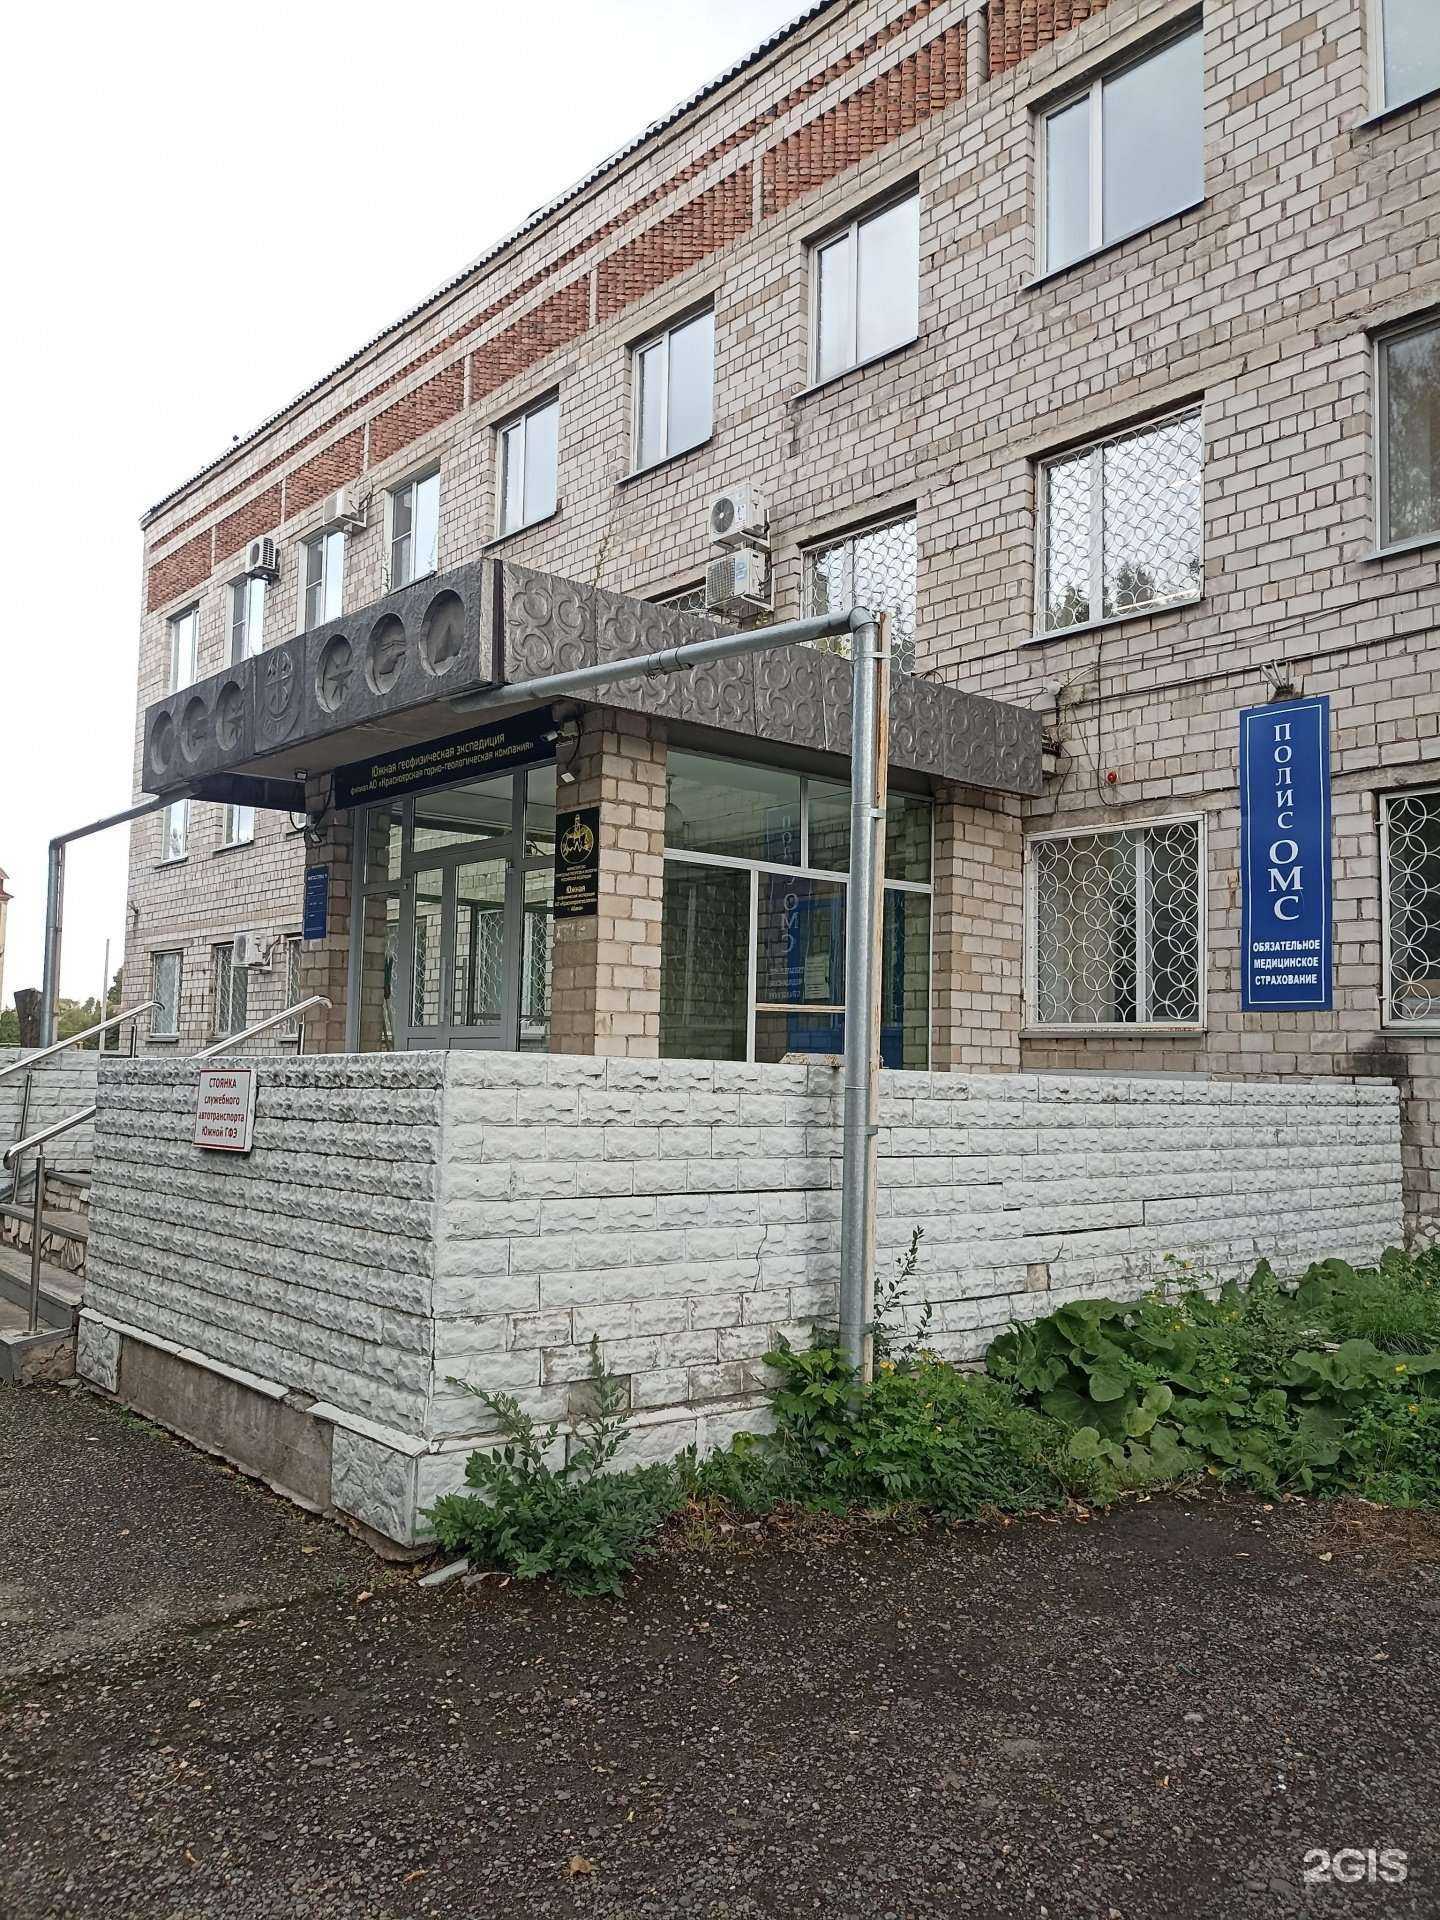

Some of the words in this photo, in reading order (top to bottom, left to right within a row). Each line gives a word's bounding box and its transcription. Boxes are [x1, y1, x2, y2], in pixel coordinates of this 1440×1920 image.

[371, 763, 397, 778] Южная
[397, 747, 454, 770] геофизическая
[456, 733, 505, 756] экспедиция
[369, 779, 378, 790] АО
[424, 752, 493, 776] горно-геологическая
[494, 742, 534, 758] компания»
[1273, 722, 1294, 830] ПОЛИС
[1268, 839, 1303, 921] ОМС
[1252, 939, 1321, 952] ОБЯЗАТЕЛЬНОЕ
[1253, 956, 1319, 970] МЕДИЦИНСКОЕ
[1255, 973, 1318, 986] СТРАХОВАНИЕ
[209, 1078, 237, 1089] СТОЯНКА
[204, 1093, 240, 1106] служебного
[198, 1111, 245, 1123] автотранспорта
[201, 1125, 224, 1137] Южной
[224, 1127, 238, 1139] ГФЭ
